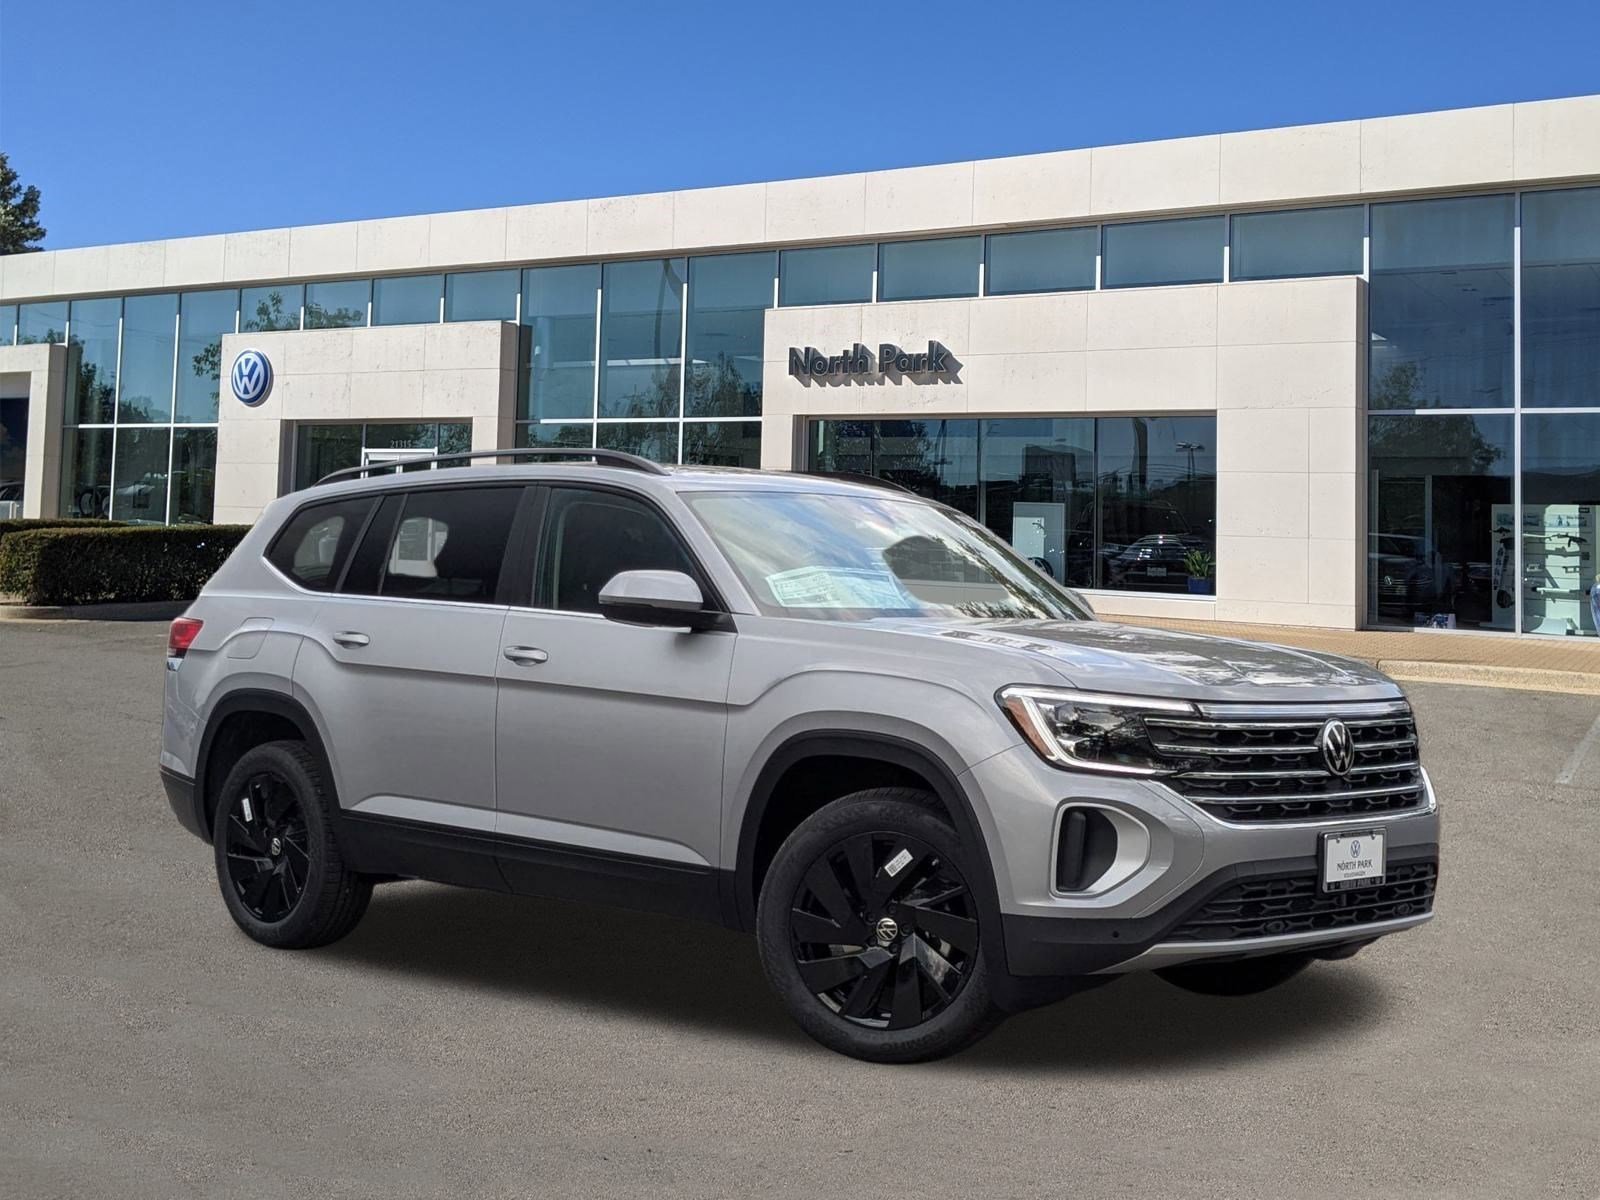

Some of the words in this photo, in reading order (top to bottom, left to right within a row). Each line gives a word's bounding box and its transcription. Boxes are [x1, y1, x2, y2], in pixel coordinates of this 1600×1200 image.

[788, 343, 873, 377] North
[878, 340, 948, 374] Park
[1336, 861, 1356, 871] NORTH
[1357, 859, 1373, 869] PARK
